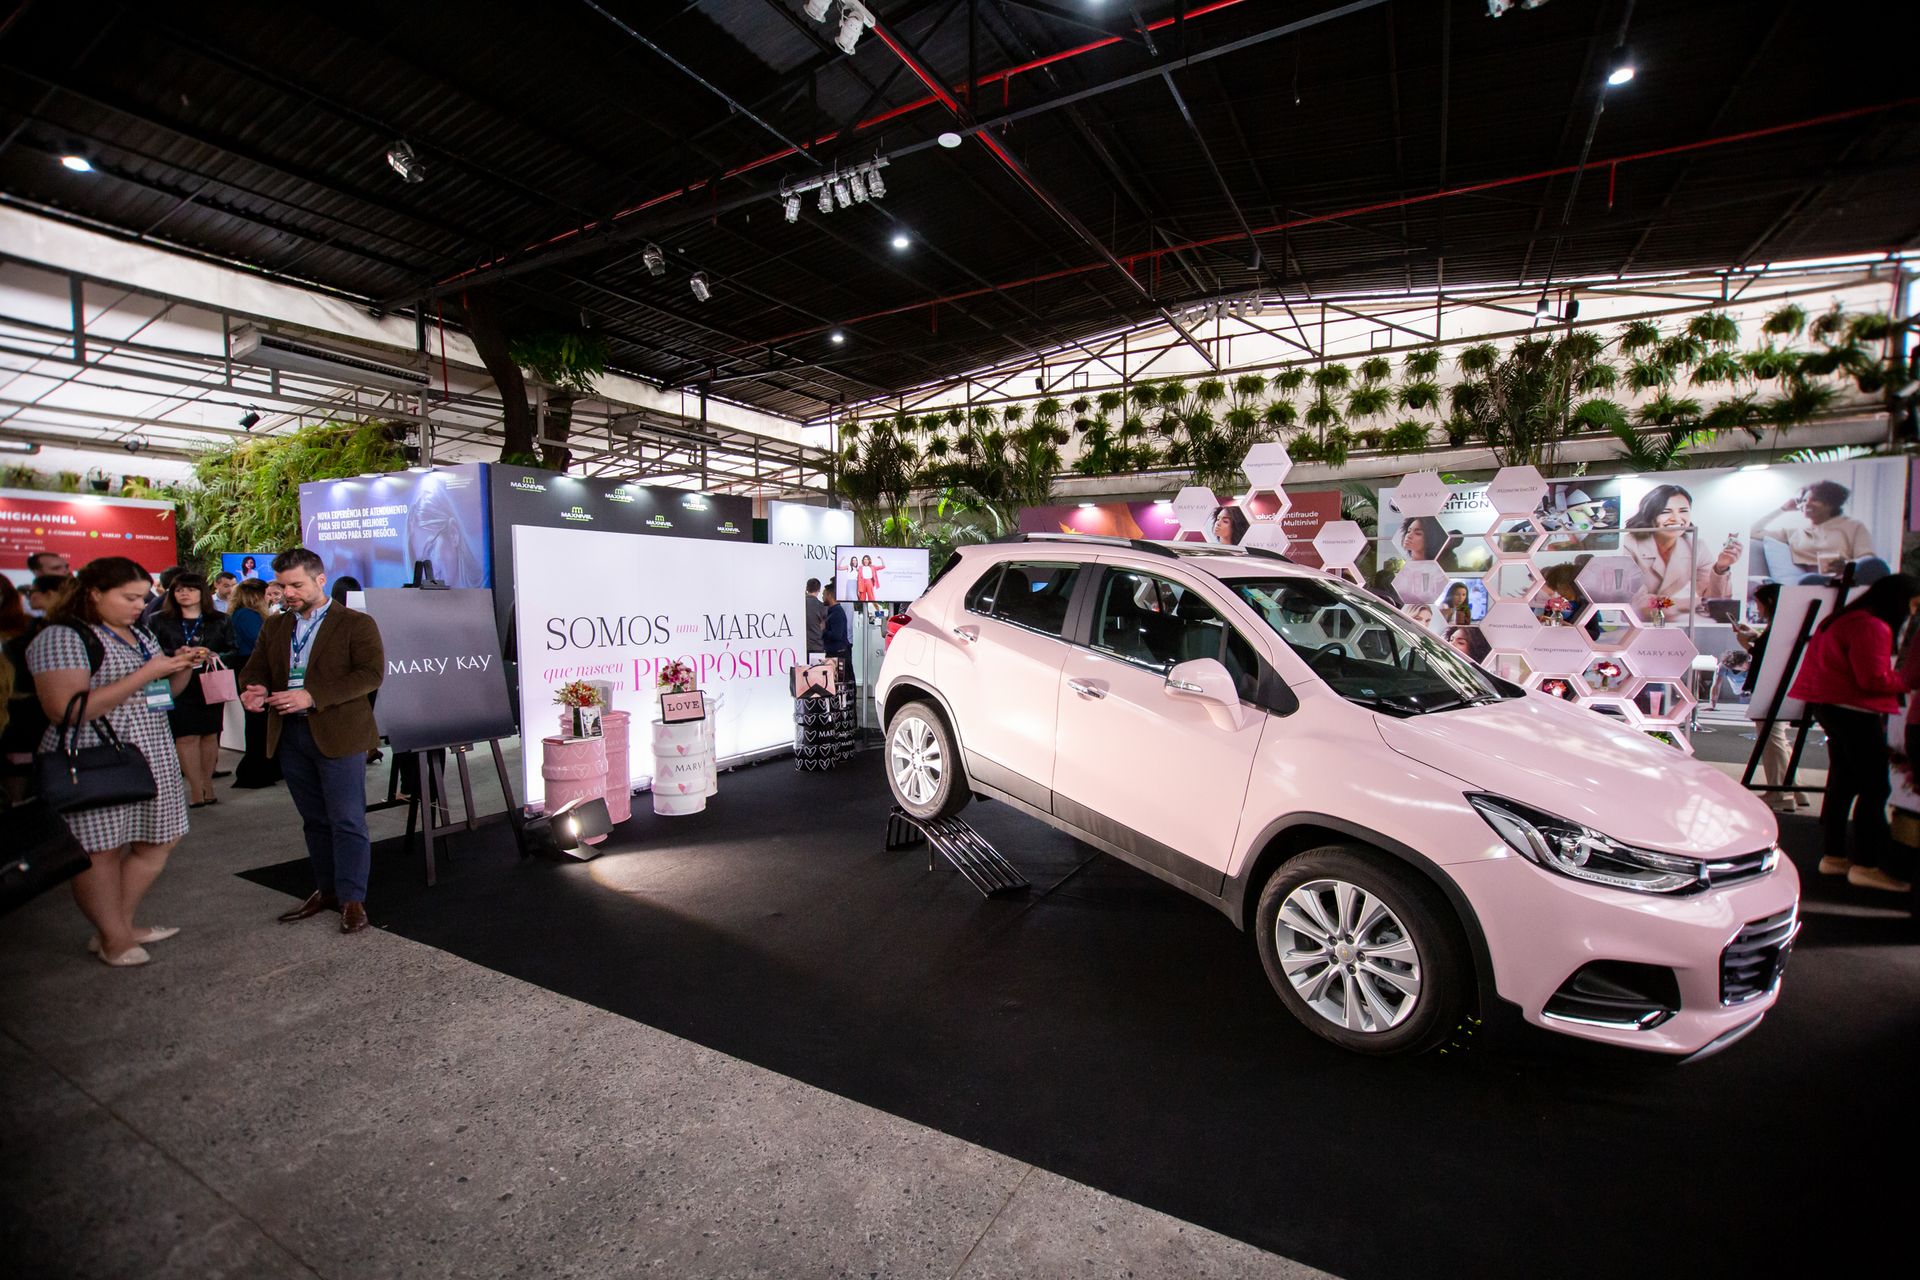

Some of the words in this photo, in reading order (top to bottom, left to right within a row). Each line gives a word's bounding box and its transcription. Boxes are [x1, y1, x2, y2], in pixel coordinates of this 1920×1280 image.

[317, 512, 331, 520] NOVA
[331, 508, 361, 520] EXPERIÊNCIA
[362, 508, 369, 517] DE
[369, 505, 408, 516] ATENDIMENTO
[318, 531, 348, 541] RESULTADOS
[347, 530, 362, 540] PARA
[362, 529, 372, 539] SEU
[546, 615, 671, 651] SOMOS
[675, 623, 700, 633] uma
[703, 613, 794, 642] MARCA
[388, 657, 448, 675] MARY
[456, 655, 492, 671] KAY
[543, 666, 573, 684] que
[576, 662, 624, 677] nasceu
[667, 700, 700, 712] LOVE
